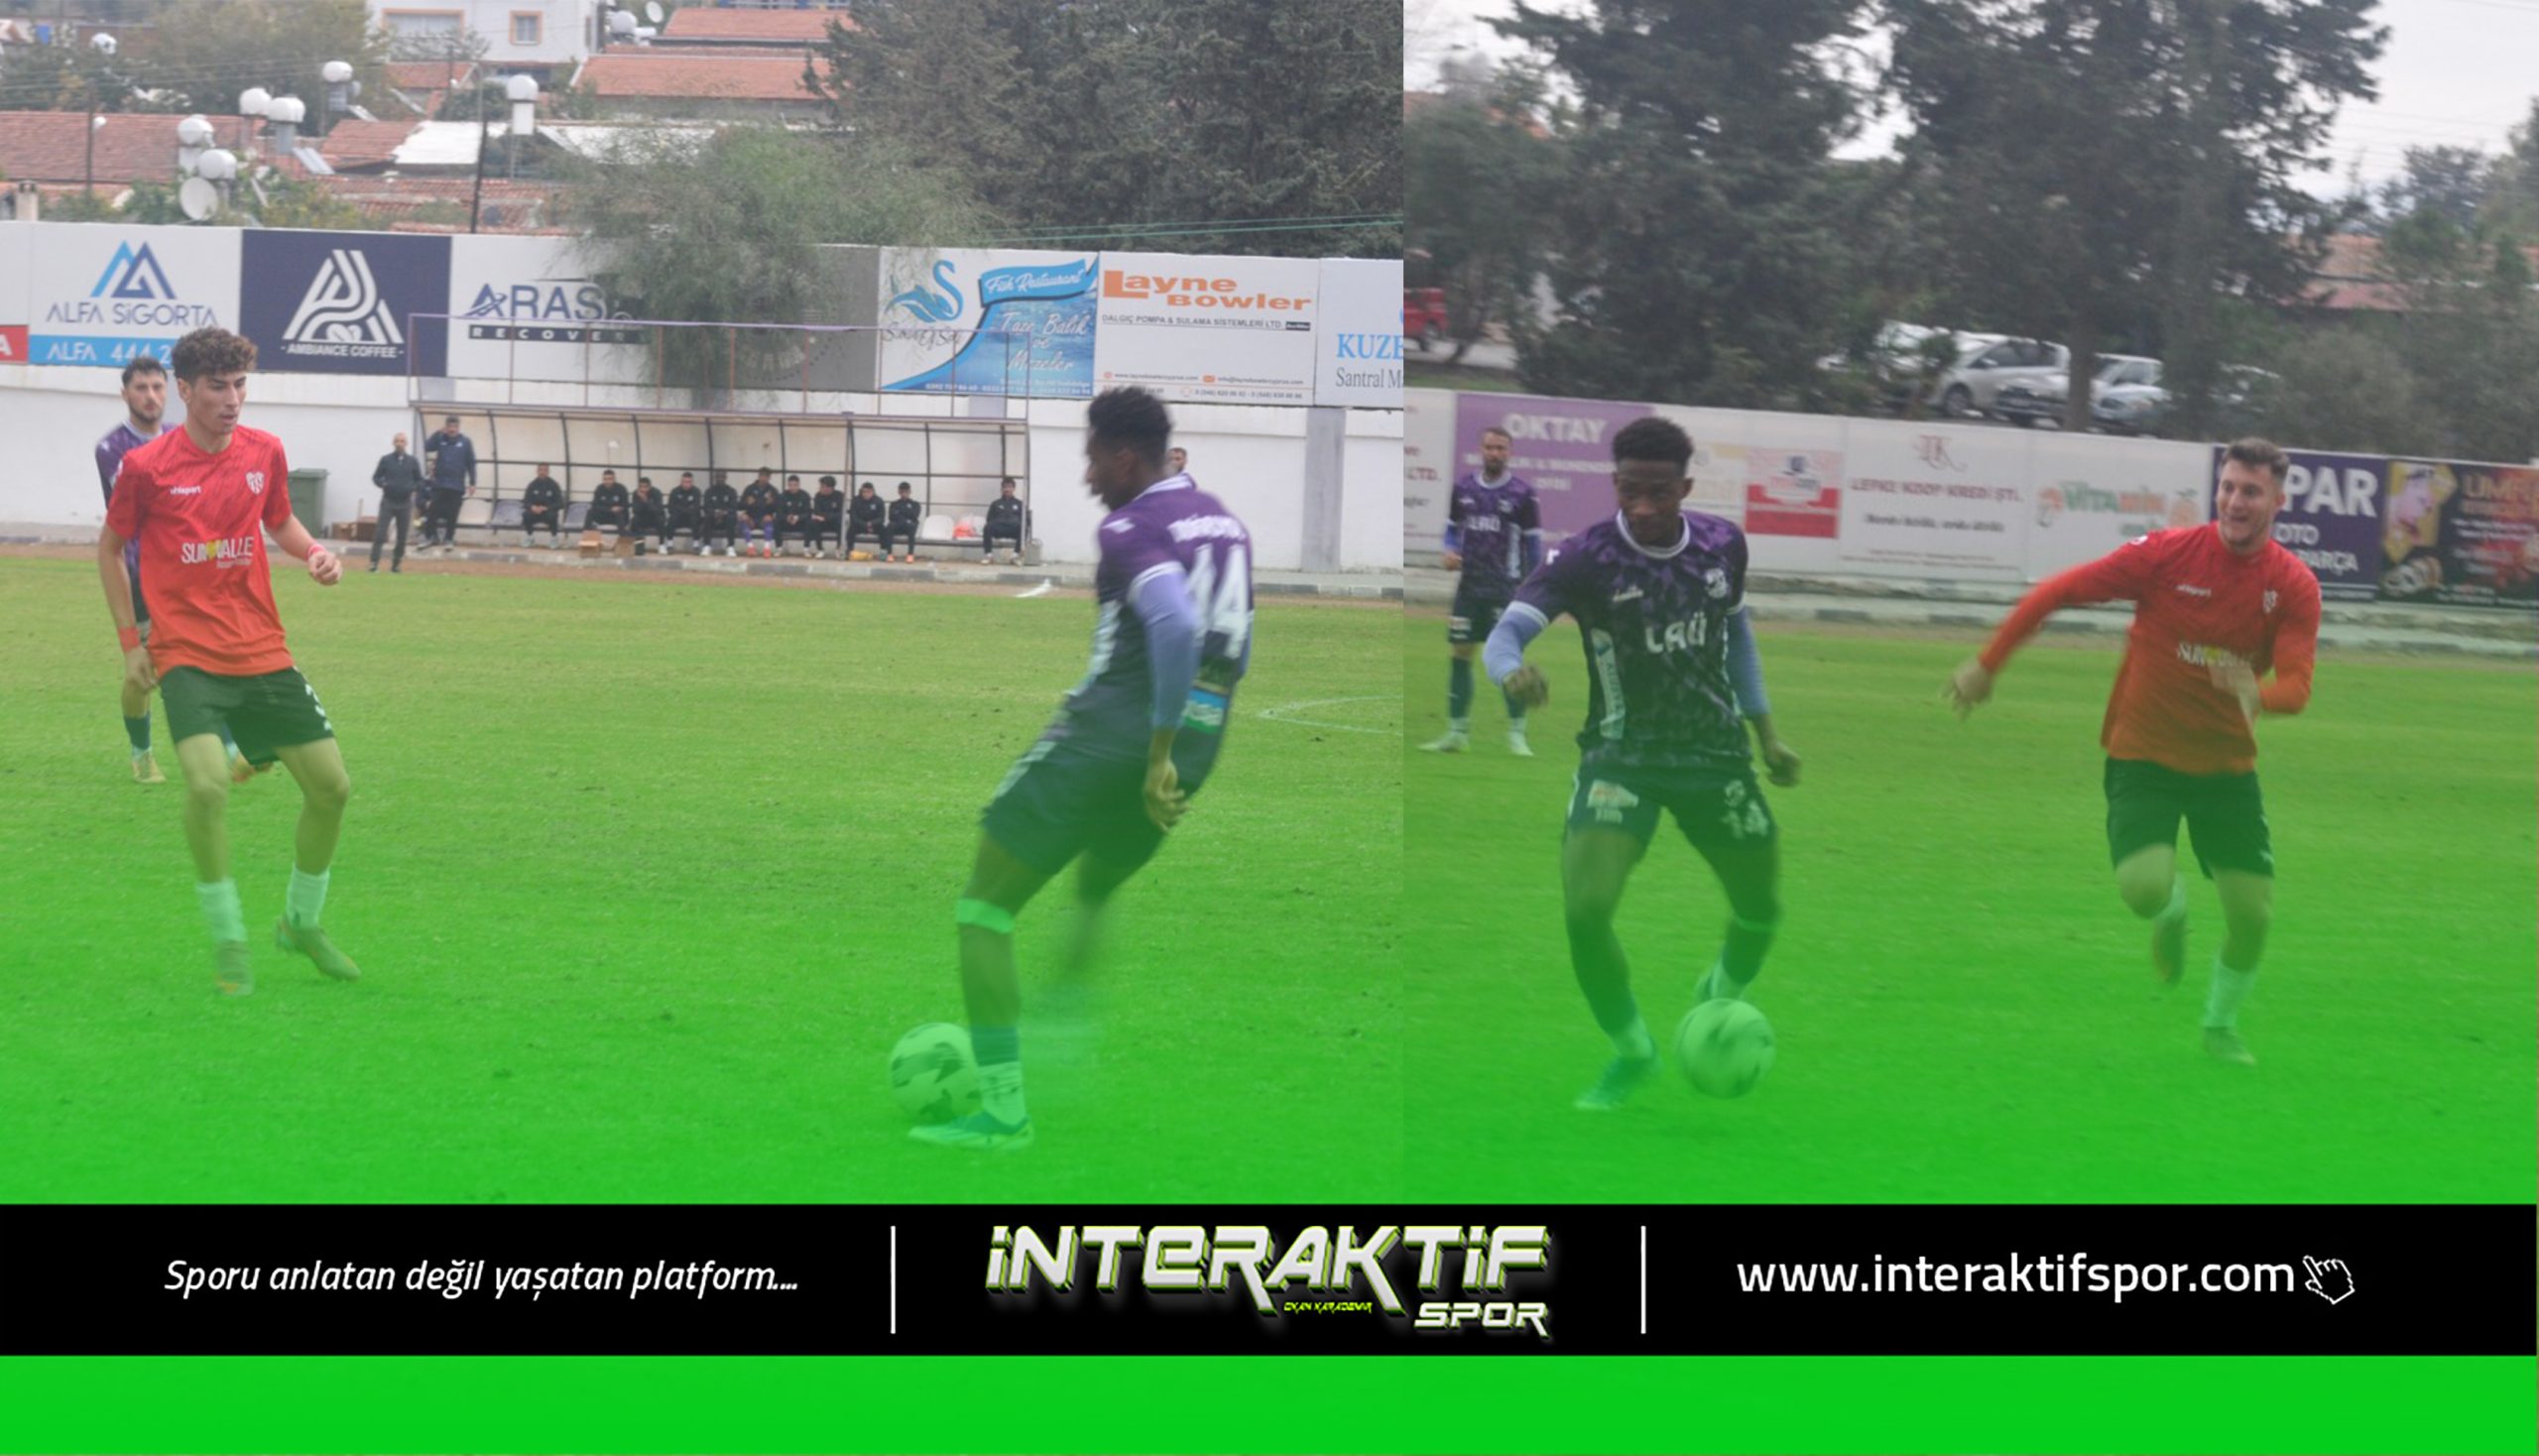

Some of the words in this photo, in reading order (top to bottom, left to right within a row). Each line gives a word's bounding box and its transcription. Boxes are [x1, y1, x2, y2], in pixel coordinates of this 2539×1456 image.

[1104, 270, 1238, 301] Layne
[1166, 294, 1312, 310] Bowler
[46, 302, 104, 323] ALFA
[1136, 315, 1165, 324] POMPA
[1167, 316, 1174, 325] &
[1176, 316, 1211, 326] SULAMA
[48, 342, 97, 361] ALFA
[287, 343, 349, 356] AMBIANCE
[350, 346, 398, 358] COFFEE
[1336, 367, 1385, 389] Santral
[1502, 413, 1607, 443] OKTAY
